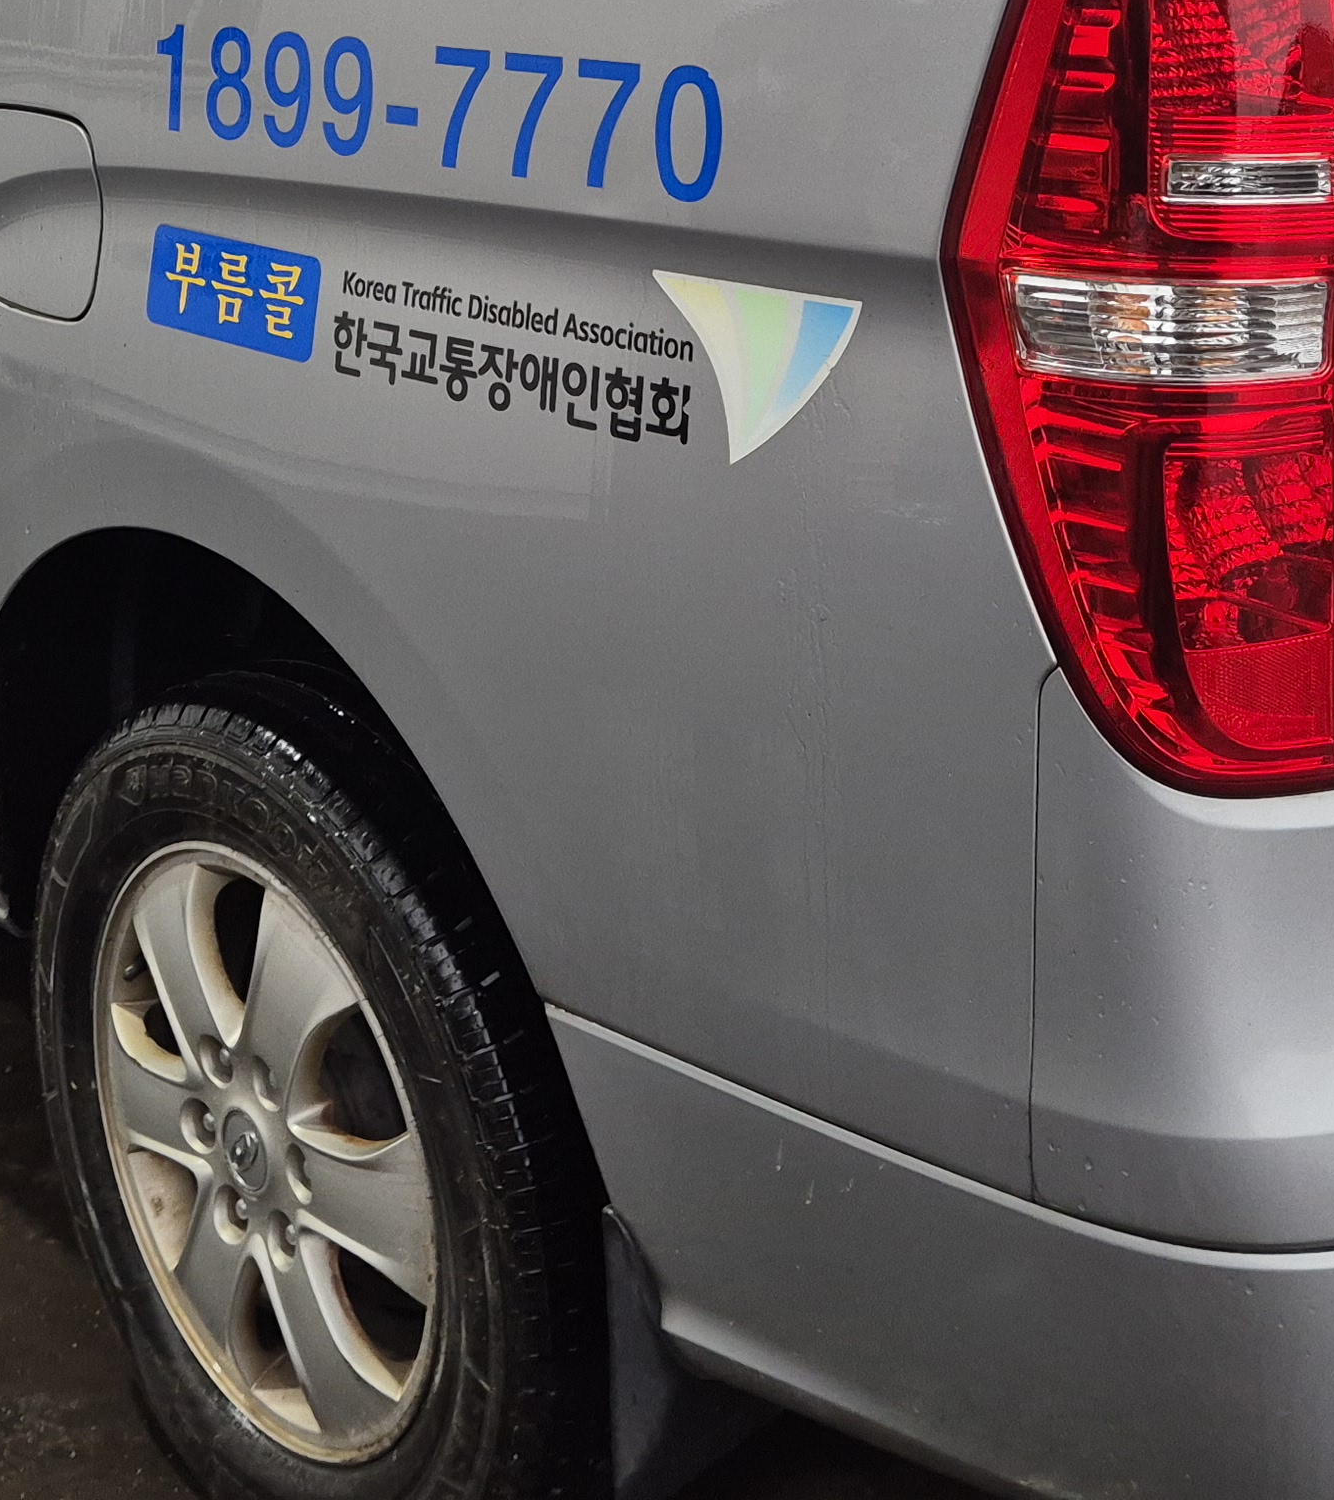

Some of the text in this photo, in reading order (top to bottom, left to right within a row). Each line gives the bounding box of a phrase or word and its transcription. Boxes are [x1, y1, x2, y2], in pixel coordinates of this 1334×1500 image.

[156, 23, 723, 202] 1899-7770
[165, 242, 305, 339] 부름콜
[342, 270, 694, 362] Korea Traffic Disabled Association
[333, 311, 692, 446] 한국교통장애인협회
